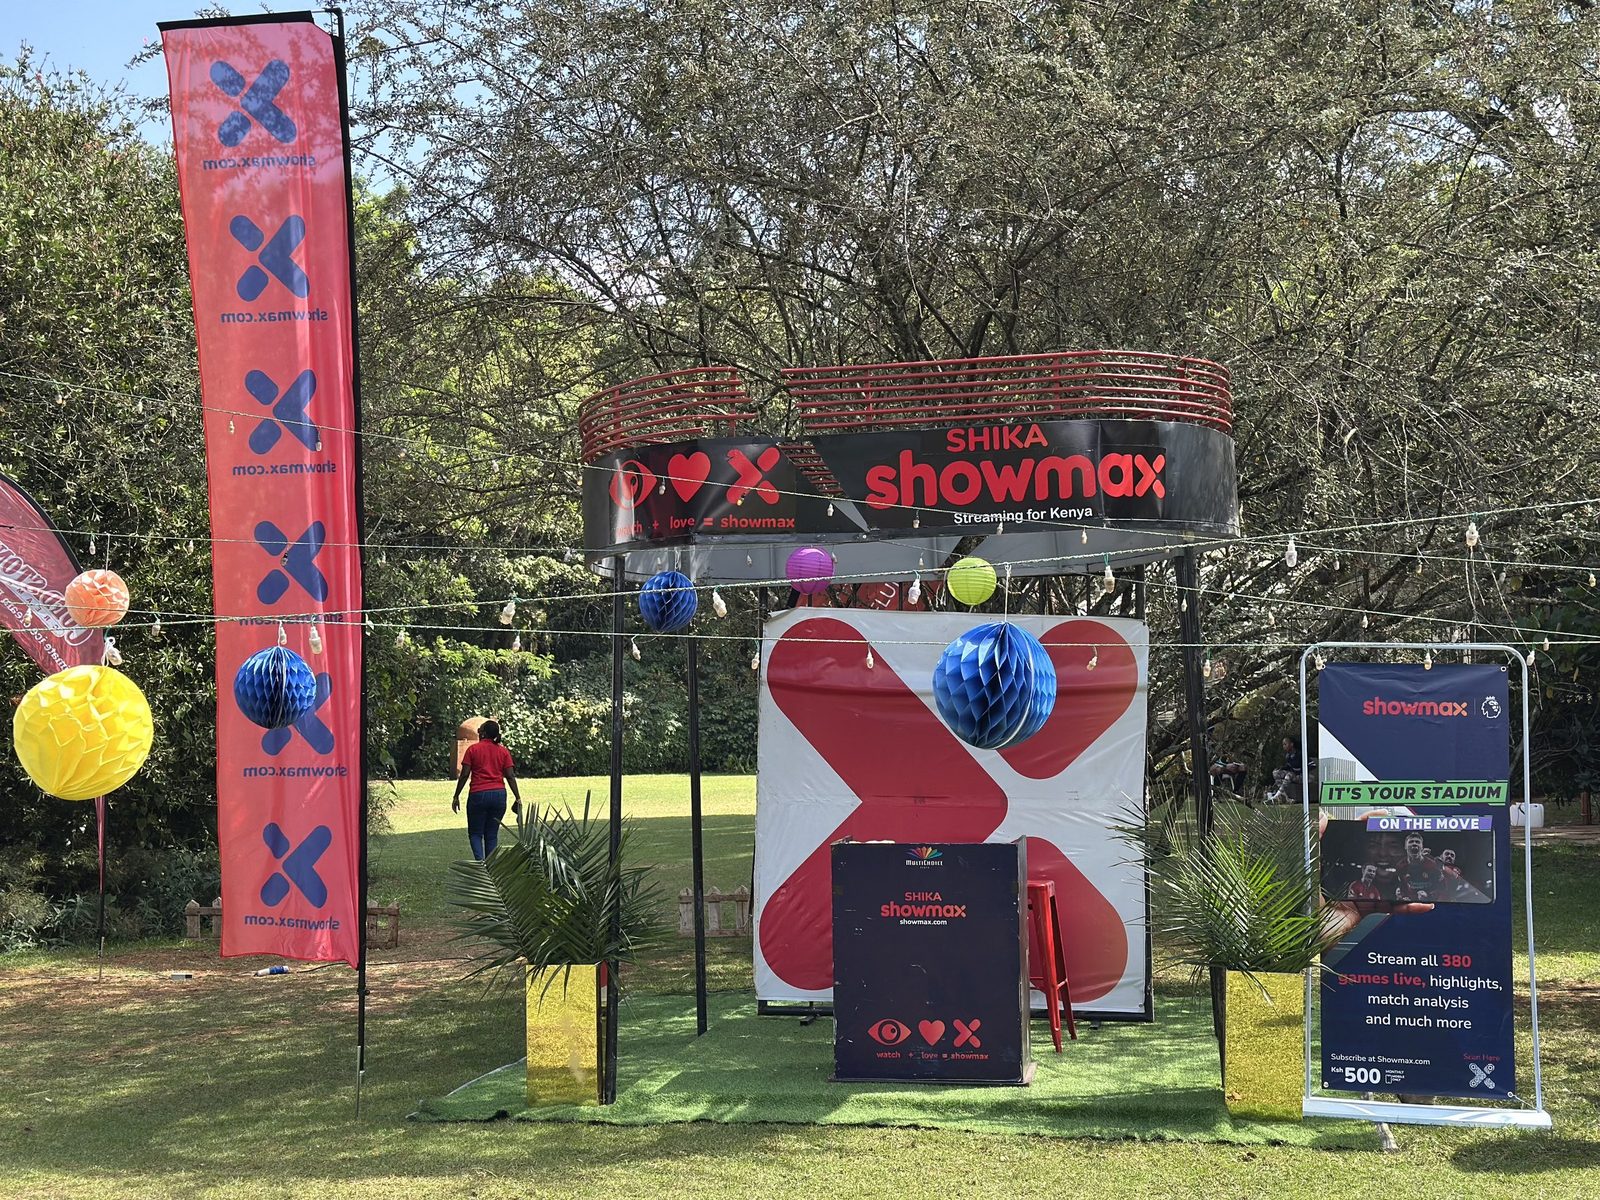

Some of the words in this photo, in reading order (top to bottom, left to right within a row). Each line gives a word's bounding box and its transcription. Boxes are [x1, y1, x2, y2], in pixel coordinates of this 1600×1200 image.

[946, 423, 1049, 452] SHIKA
[865, 449, 1166, 509] showmax
[670, 516, 695, 529] love
[721, 514, 795, 529] showmax
[953, 510, 1024, 524] Streaming
[1027, 508, 1047, 520] for
[1050, 506, 1093, 520] Kenya
[1363, 696, 1468, 717] showmax
[1328, 787, 1362, 800] IT'S
[1369, 786, 1416, 800] YOUR
[1421, 786, 1502, 799] STADIUM
[1379, 819, 1400, 830] ON
[1404, 819, 1432, 830] THE
[1437, 818, 1479, 829] MOVE
[905, 892, 942, 901] SHIKA
[881, 901, 967, 918] showmax
[1368, 952, 1417, 965] Stream
[1421, 955, 1438, 966] all
[1442, 954, 1472, 968] 380
[1338, 972, 1389, 986] games
[1394, 972, 1426, 988] live,
[1430, 974, 1502, 991] highlights,
[1368, 994, 1409, 1006] match
[1414, 996, 1469, 1010] analysis
[1366, 1014, 1391, 1025] and
[1395, 1015, 1432, 1027] much
[1436, 1018, 1472, 1029] more
[921, 1051, 938, 1059] love
[951, 1051, 989, 1059] showmax
[1331, 1053, 1367, 1062] Subscribe
[1377, 1056, 1430, 1065] Showmax.com
[1345, 1067, 1381, 1084] 500
